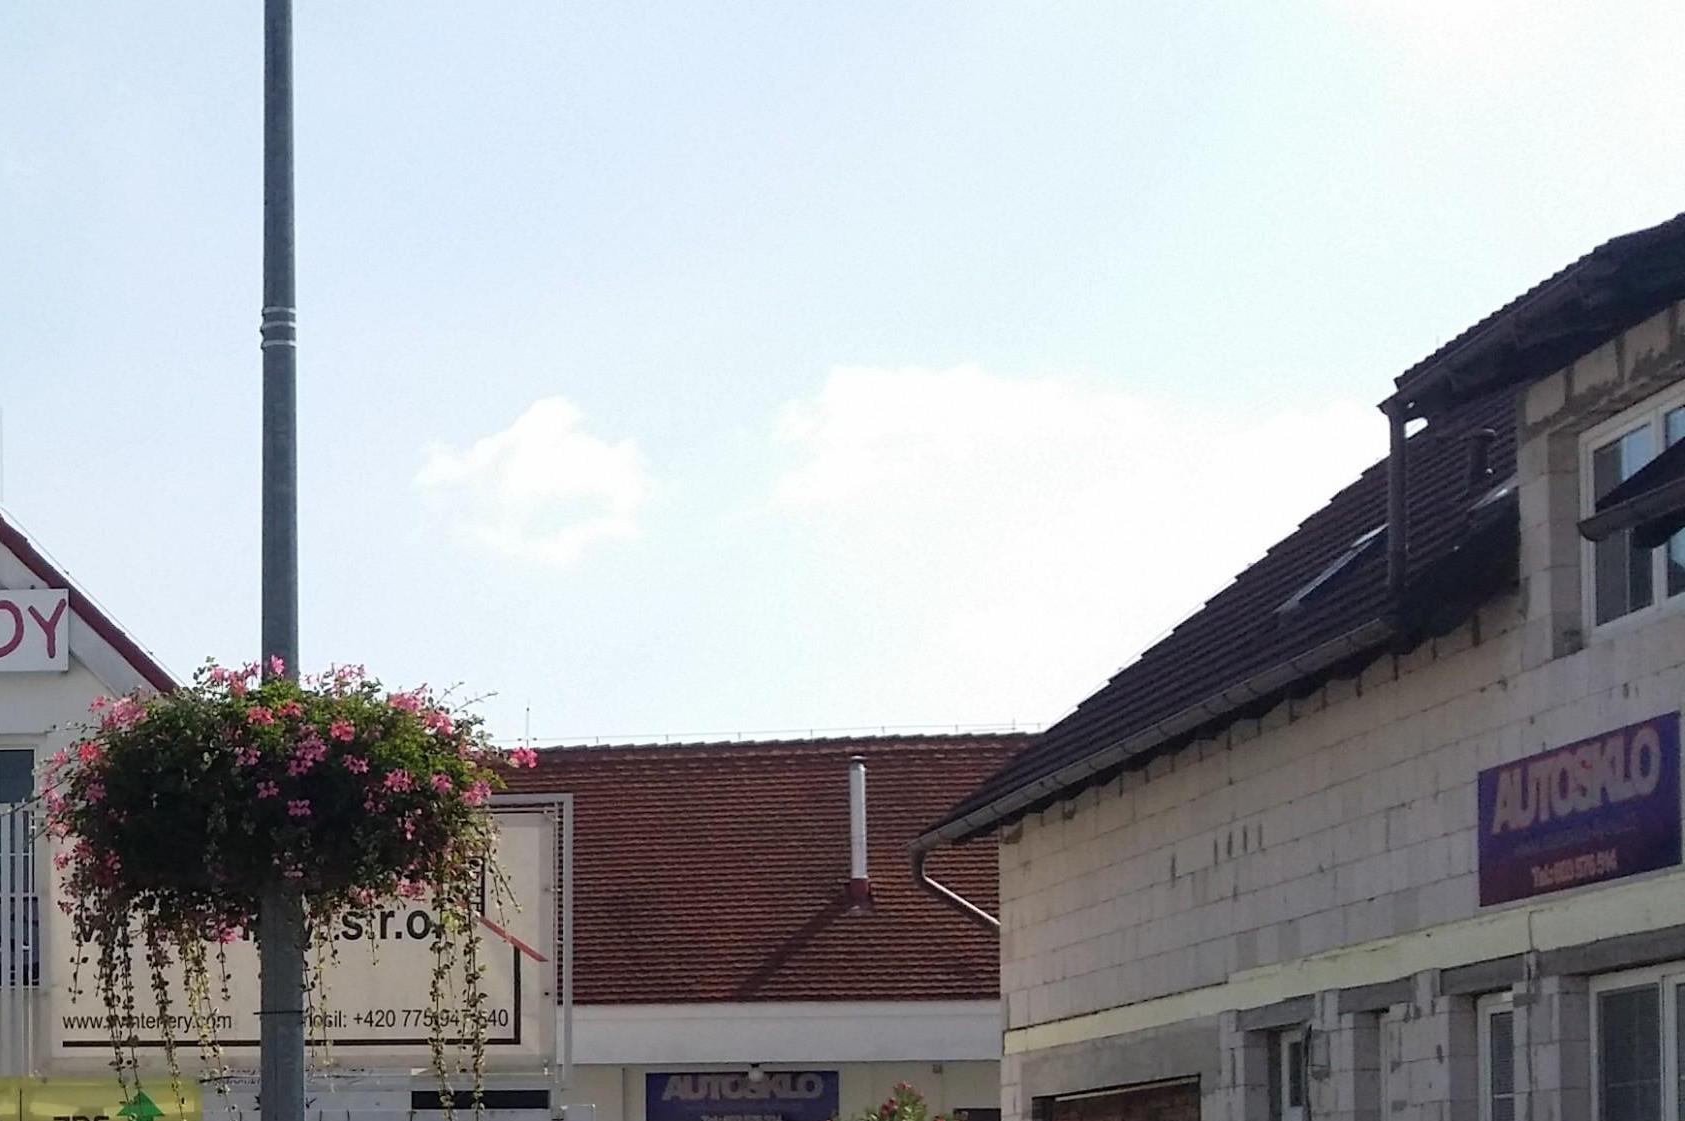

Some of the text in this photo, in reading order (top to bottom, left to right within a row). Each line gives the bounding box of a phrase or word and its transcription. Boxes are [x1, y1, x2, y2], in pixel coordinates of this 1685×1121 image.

[1492, 726, 1662, 836] AUTOSKLO
[353, 1009, 396, 1027] +420
[401, 1009, 433, 1027] 775
[662, 1073, 824, 1100] AUTOSKLO
